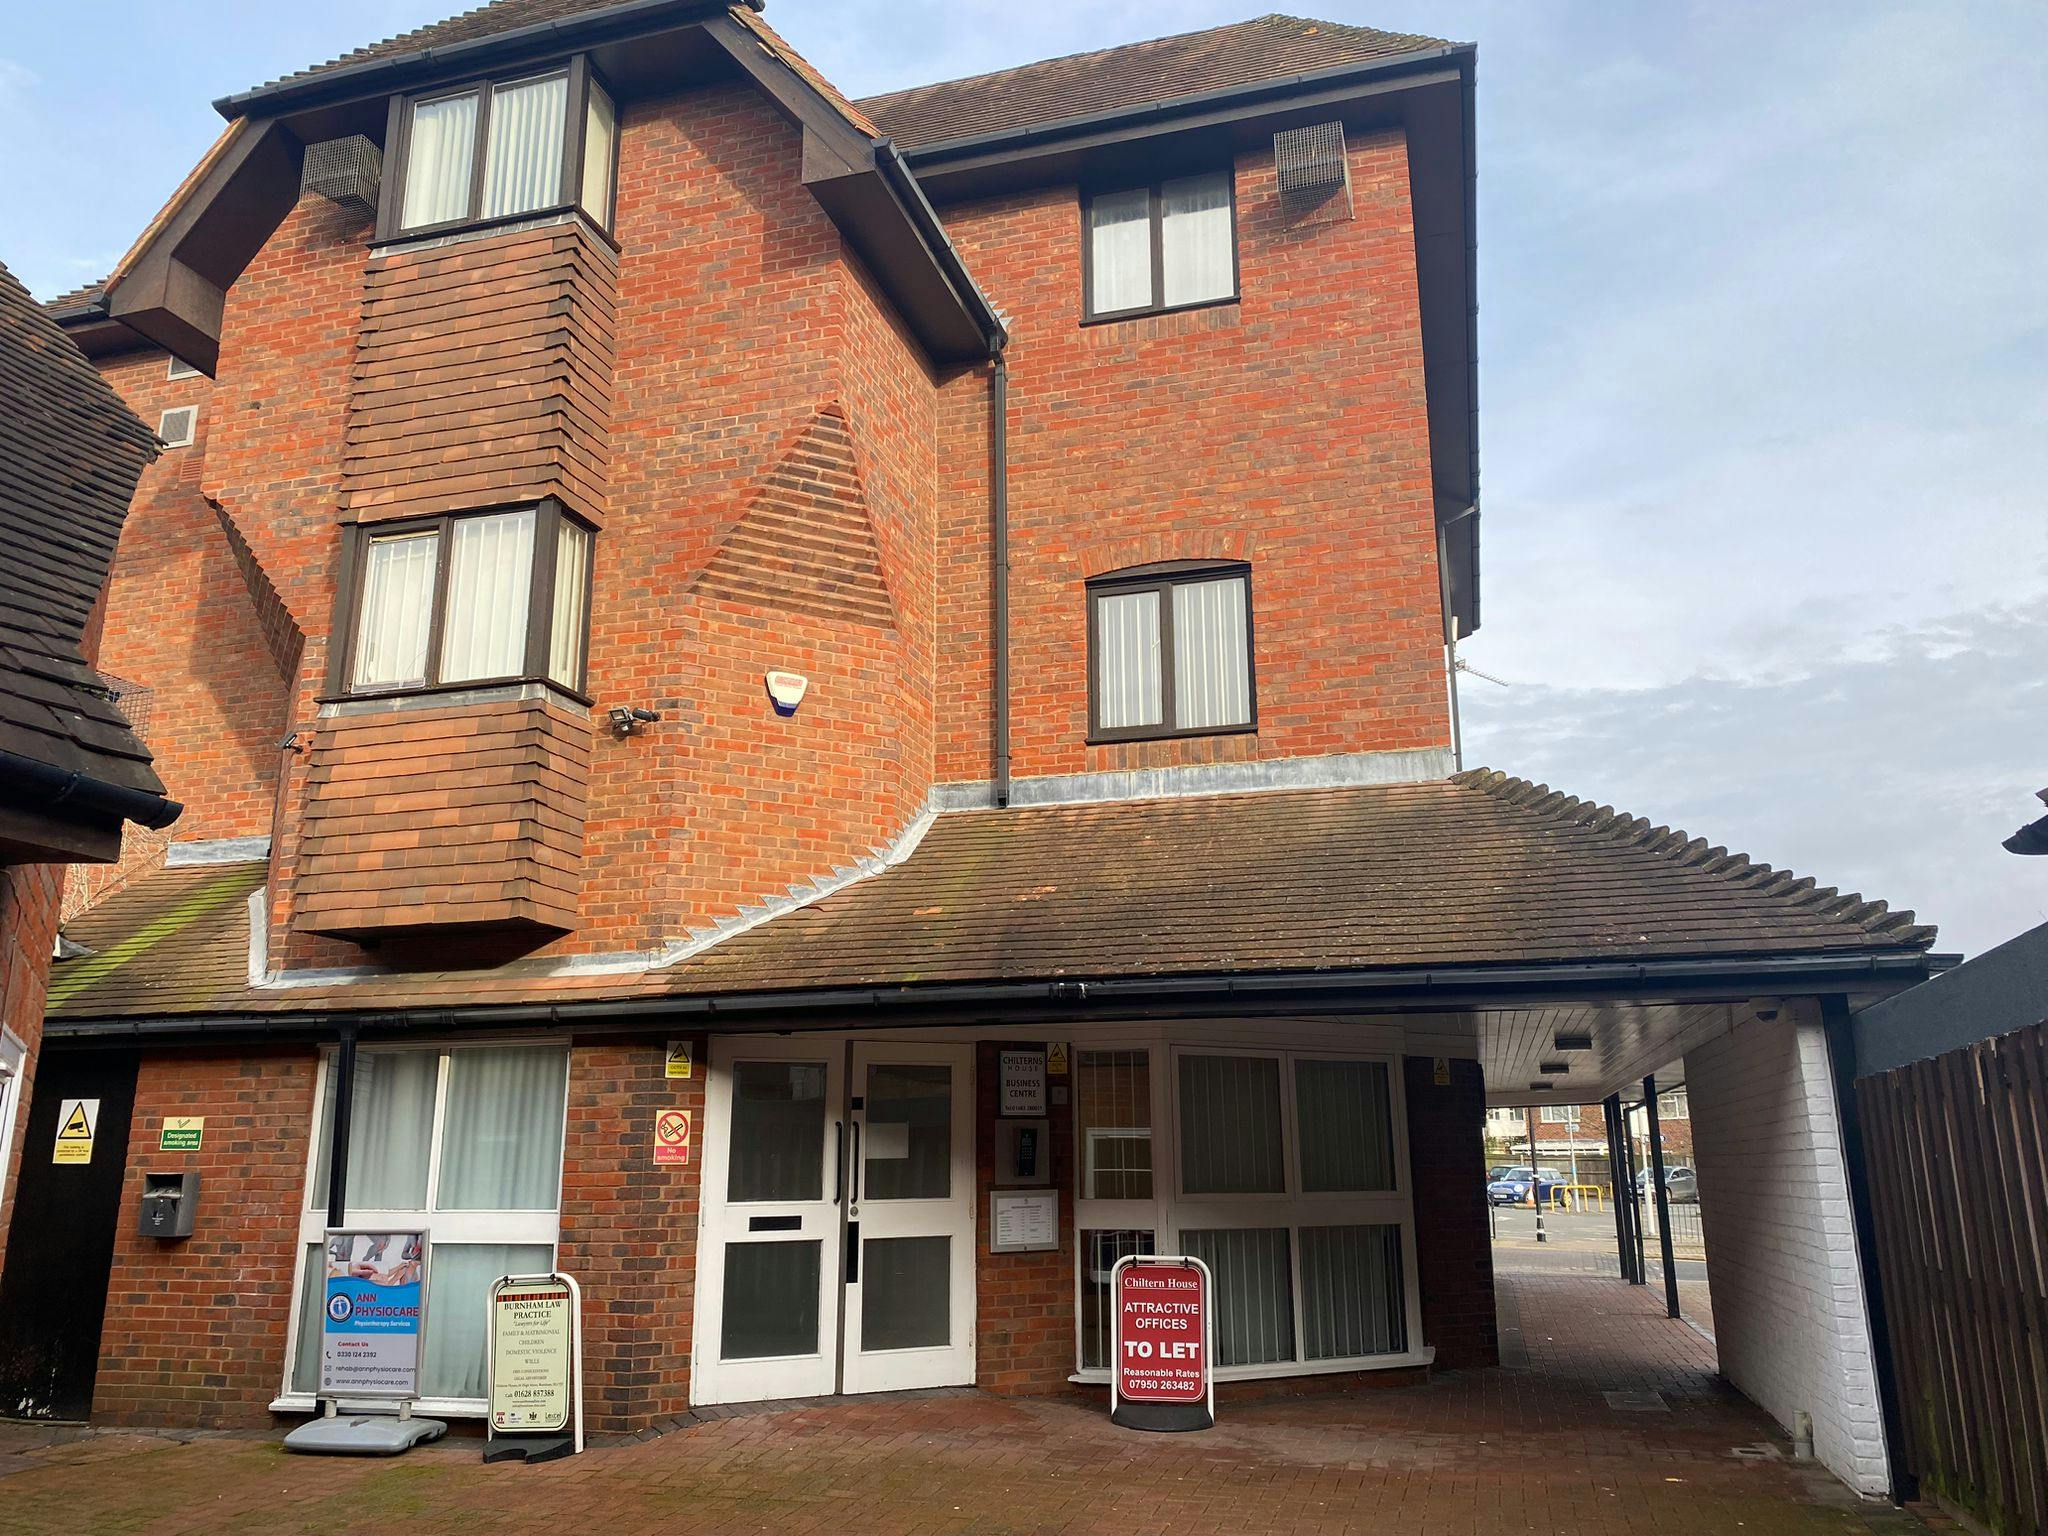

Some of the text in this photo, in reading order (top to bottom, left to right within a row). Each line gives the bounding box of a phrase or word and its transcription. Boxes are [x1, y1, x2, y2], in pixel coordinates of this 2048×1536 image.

[1003, 1056, 1043, 1065] CHILTERNS
[1006, 1079, 1040, 1087] BUSINESS
[1009, 1089, 1037, 1098] CENTRE
[167, 1132, 197, 1141] Designated
[656, 1155, 686, 1163] smoking
[1124, 1277, 1198, 1289] Chiltern House
[356, 1293, 377, 1302] ANN
[504, 1302, 544, 1310] BURNHAM
[1124, 1302, 1199, 1314] ATTRACTIVE
[355, 1306, 419, 1317] PHYSIOCARE
[513, 1311, 552, 1319] PRACTICE
[1135, 1318, 1188, 1330] OFFICES
[1124, 1341, 1200, 1359] TO LET
[335, 1365, 417, 1373] rehab@annphysiocare.com
[1123, 1367, 1200, 1378] Reasonable Rates
[1129, 1379, 1195, 1391] 07950 263482
